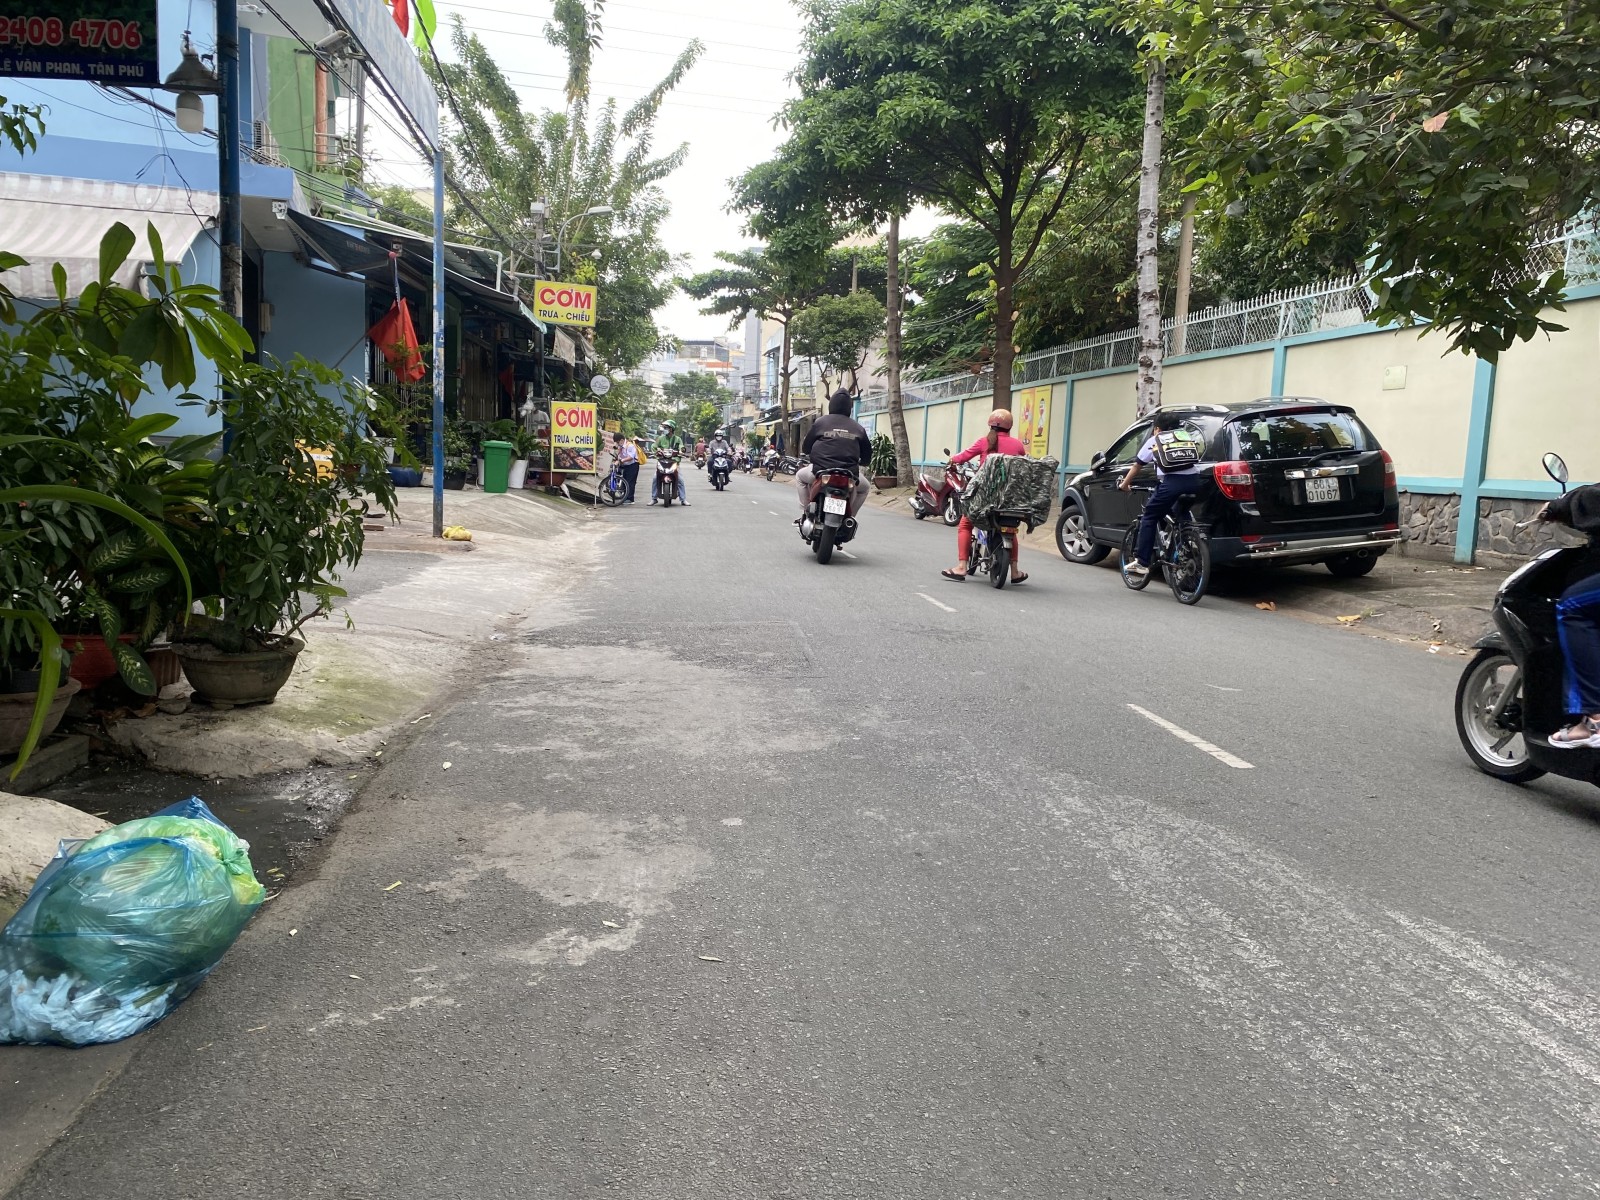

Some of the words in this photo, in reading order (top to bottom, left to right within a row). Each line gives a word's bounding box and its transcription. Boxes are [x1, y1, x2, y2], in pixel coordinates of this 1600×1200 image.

[70, 18, 143, 50] 4706
[118, 62, 145, 77] PHÚ
[539, 286, 592, 310] CƠM
[555, 407, 593, 428] CƠM
